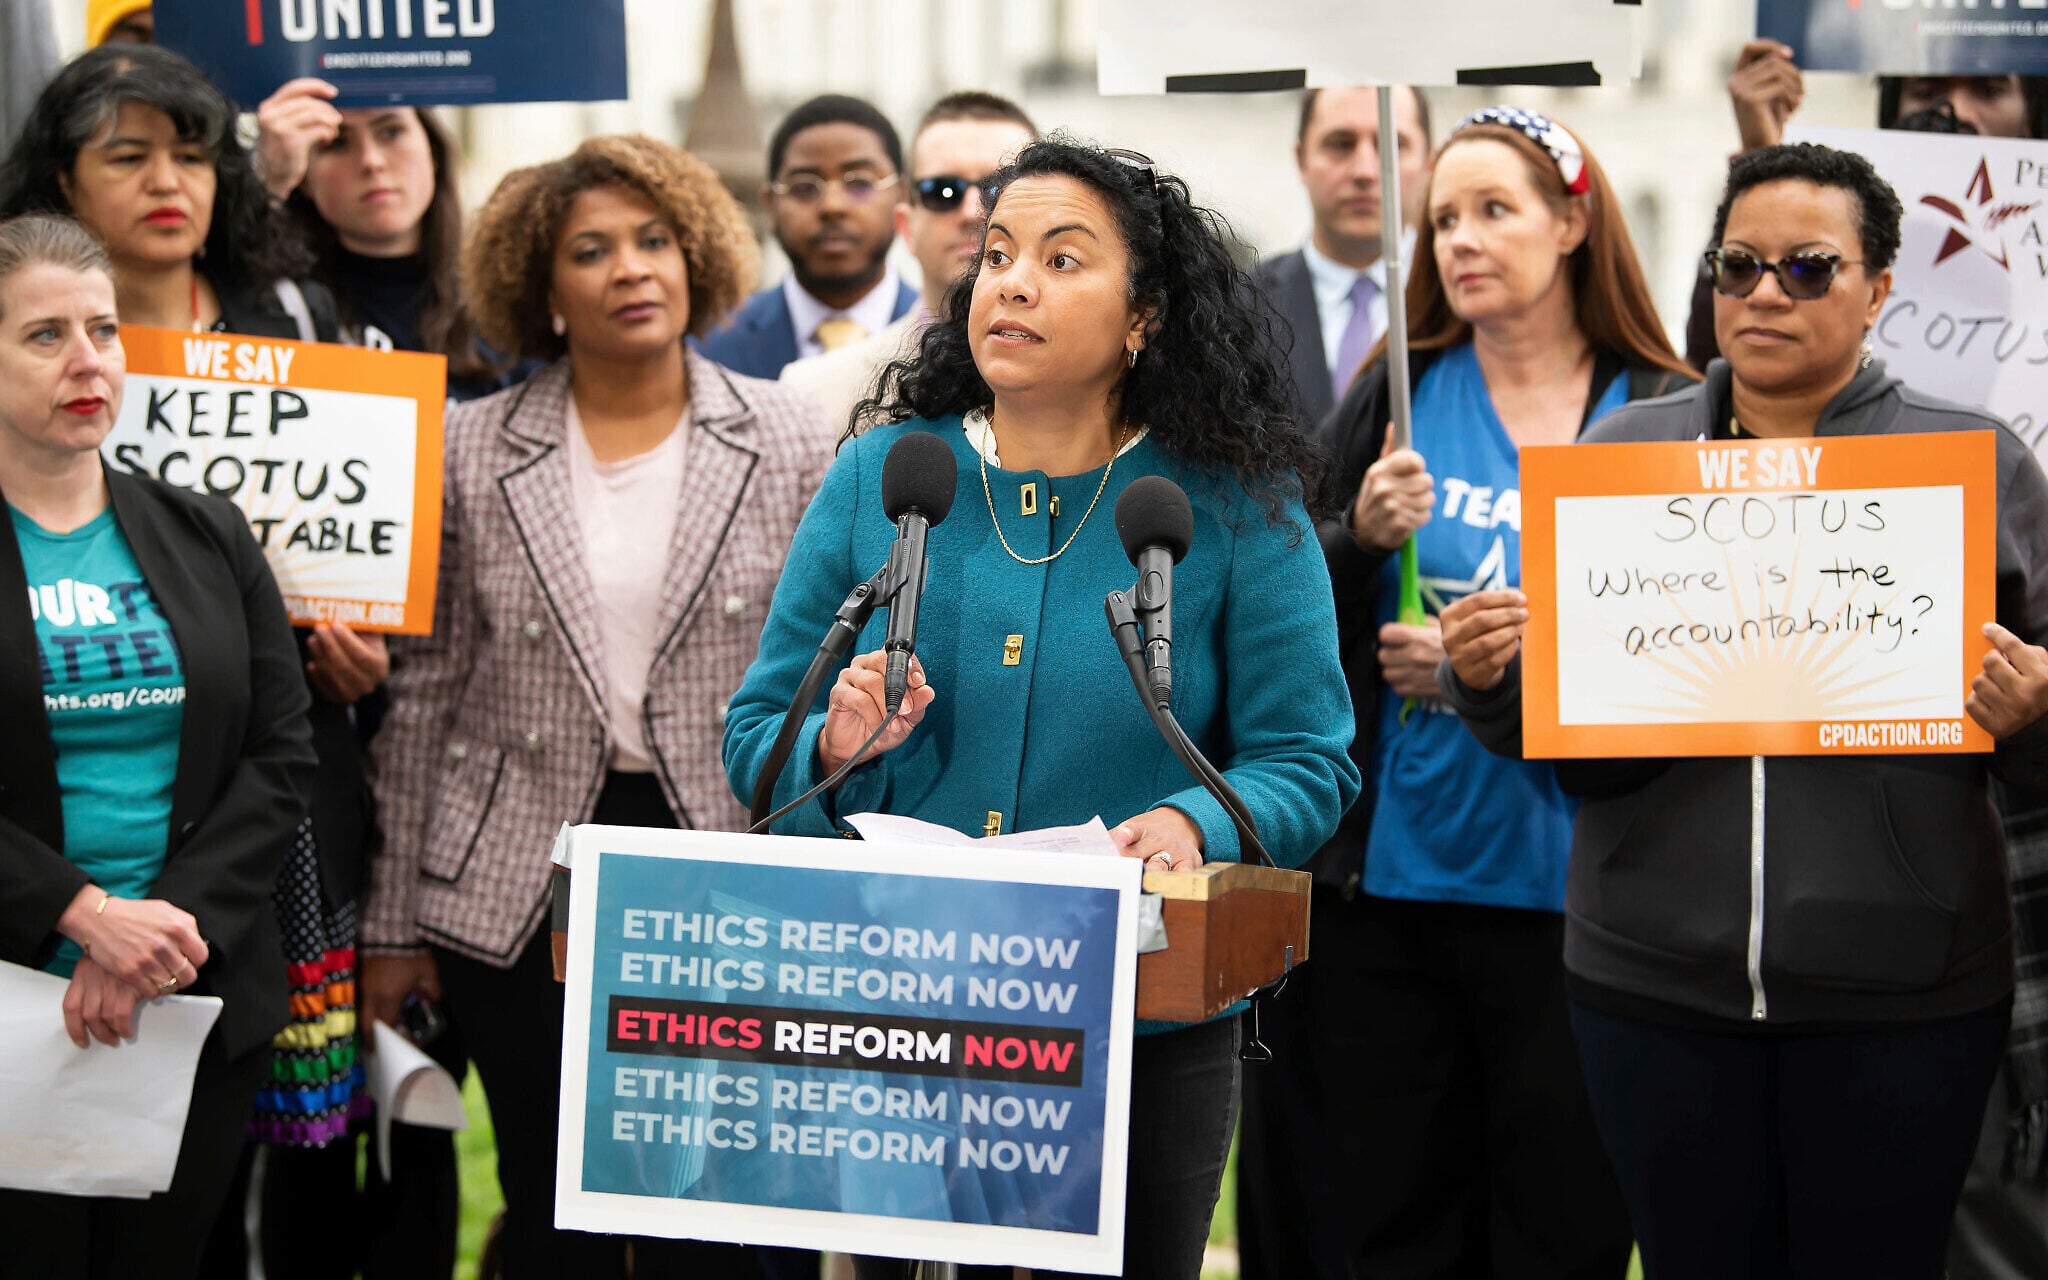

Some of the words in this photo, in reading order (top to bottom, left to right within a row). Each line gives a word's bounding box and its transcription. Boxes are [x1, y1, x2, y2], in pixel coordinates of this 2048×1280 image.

[184, 339, 230, 378] WE
[235, 342, 295, 384] SAY
[1877, 298, 2048, 366] COTUS
[146, 386, 309, 438] KEEP
[115, 444, 369, 505] SCOTUS
[1697, 449, 1749, 488] WE
[1756, 447, 1822, 487] SAY
[1655, 495, 1886, 543] SCOTUS
[1588, 567, 1725, 597] Where
[1755, 561, 1787, 586] is
[1820, 556, 1895, 587] the
[1626, 595, 1933, 655] accountability?
[1820, 722, 1962, 747] CPDACTION.ORG
[623, 908, 768, 948] ETHICS
[781, 919, 955, 961] REFORM
[970, 934, 1080, 970] NOW
[620, 952, 765, 992] ETHICS
[778, 964, 954, 1005] REFORM
[967, 979, 1078, 1014] NOW
[617, 1009, 762, 1050] ETHICS
[774, 1021, 951, 1064] REFORM
[964, 1035, 1075, 1073] NOW
[614, 1067, 759, 1106] ETHICS
[772, 1079, 947, 1121] REFORM
[960, 1094, 1071, 1131] NOW
[612, 1111, 757, 1151] ETHICS
[770, 1123, 944, 1166] REFORM
[959, 1138, 1069, 1175] NOW
